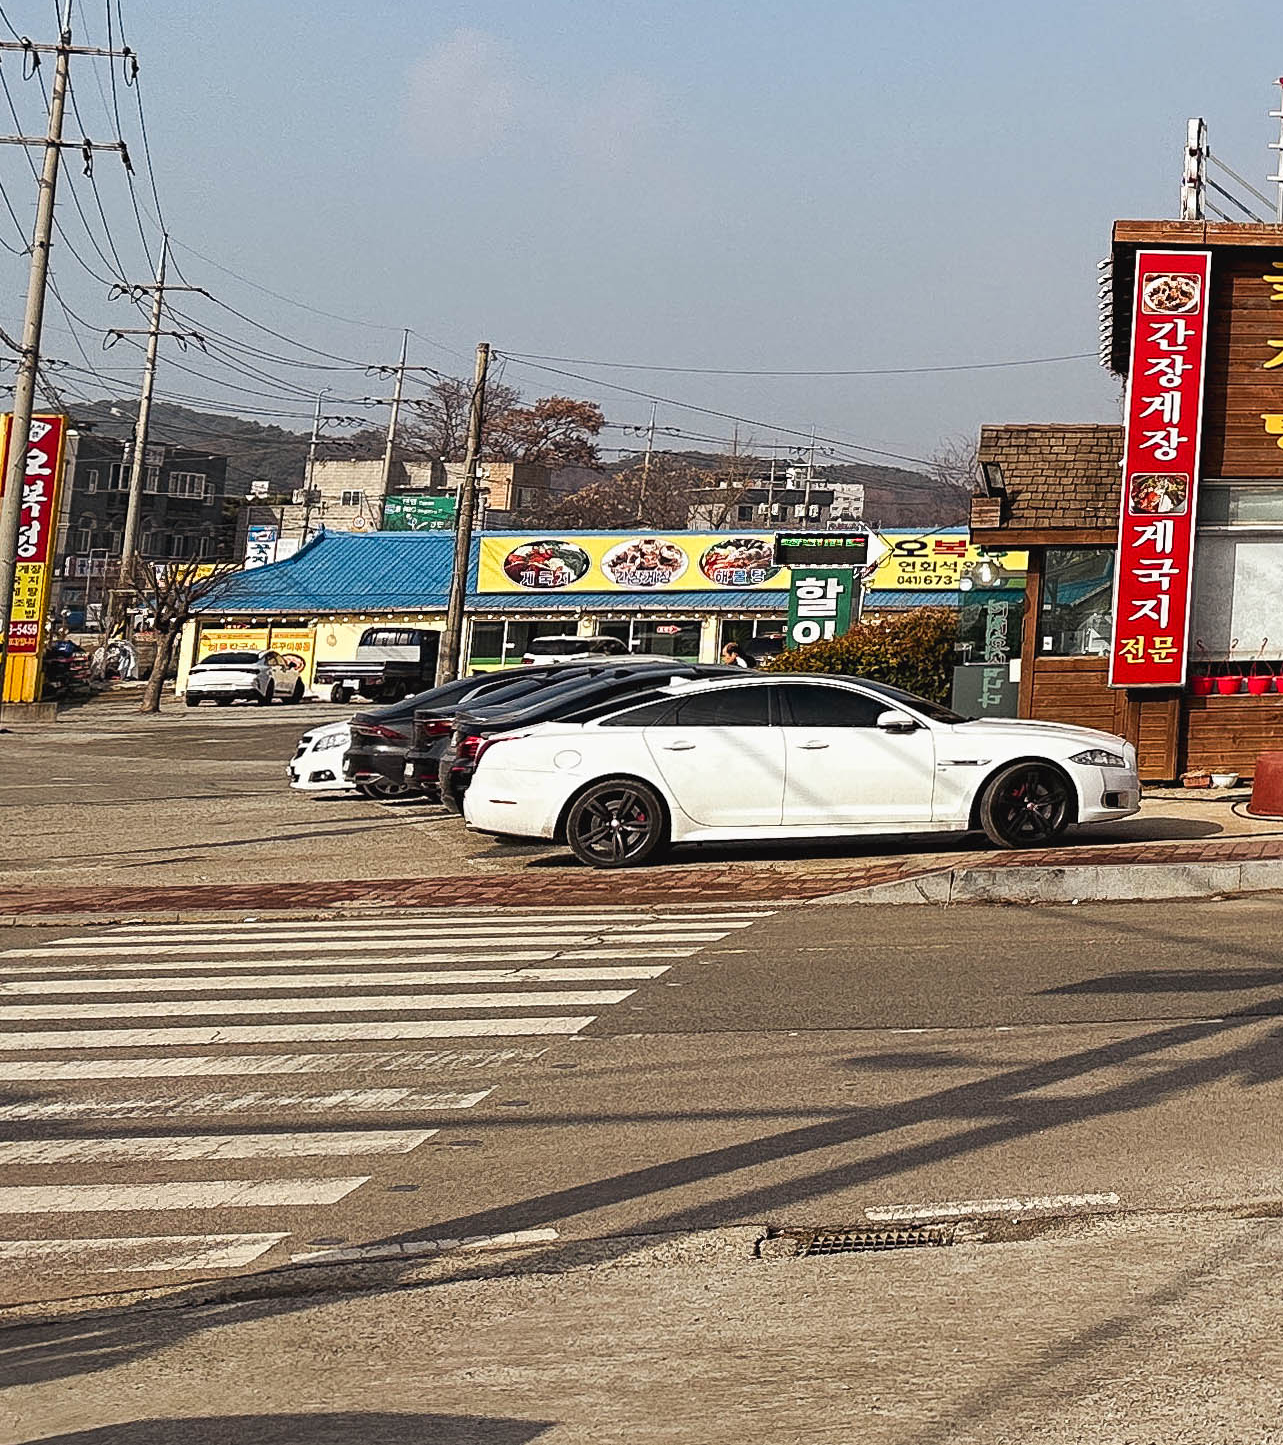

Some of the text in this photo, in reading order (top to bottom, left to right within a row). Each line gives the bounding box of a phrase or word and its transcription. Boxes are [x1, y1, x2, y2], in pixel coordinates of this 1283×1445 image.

[1139, 319, 1195, 461] 간장게장
[1127, 519, 1179, 631] 게국지
[1118, 635, 1178, 664] 전문
